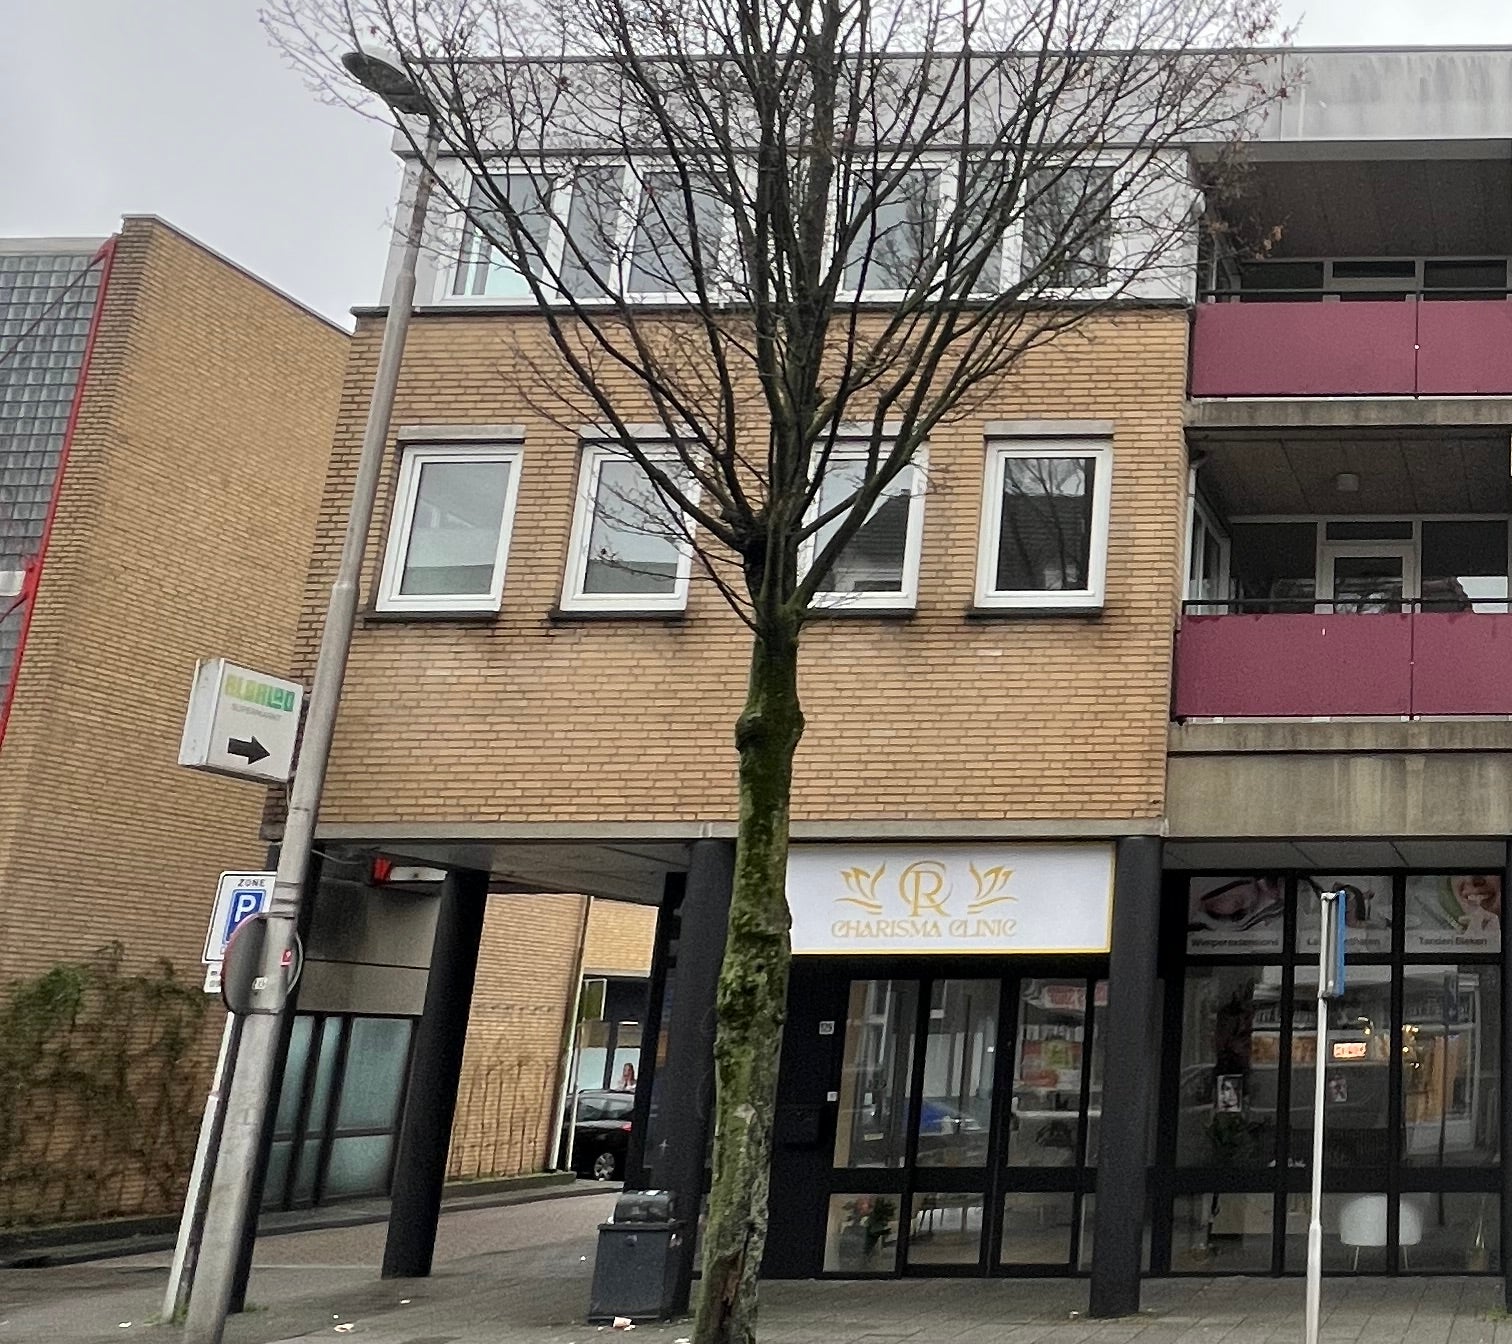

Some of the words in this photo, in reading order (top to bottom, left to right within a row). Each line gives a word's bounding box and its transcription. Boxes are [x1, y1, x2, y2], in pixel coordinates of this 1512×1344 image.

[237, 878, 267, 888] ZONE
[831, 919, 942, 938] CHARISMA
[949, 919, 1018, 938] CLINIC
